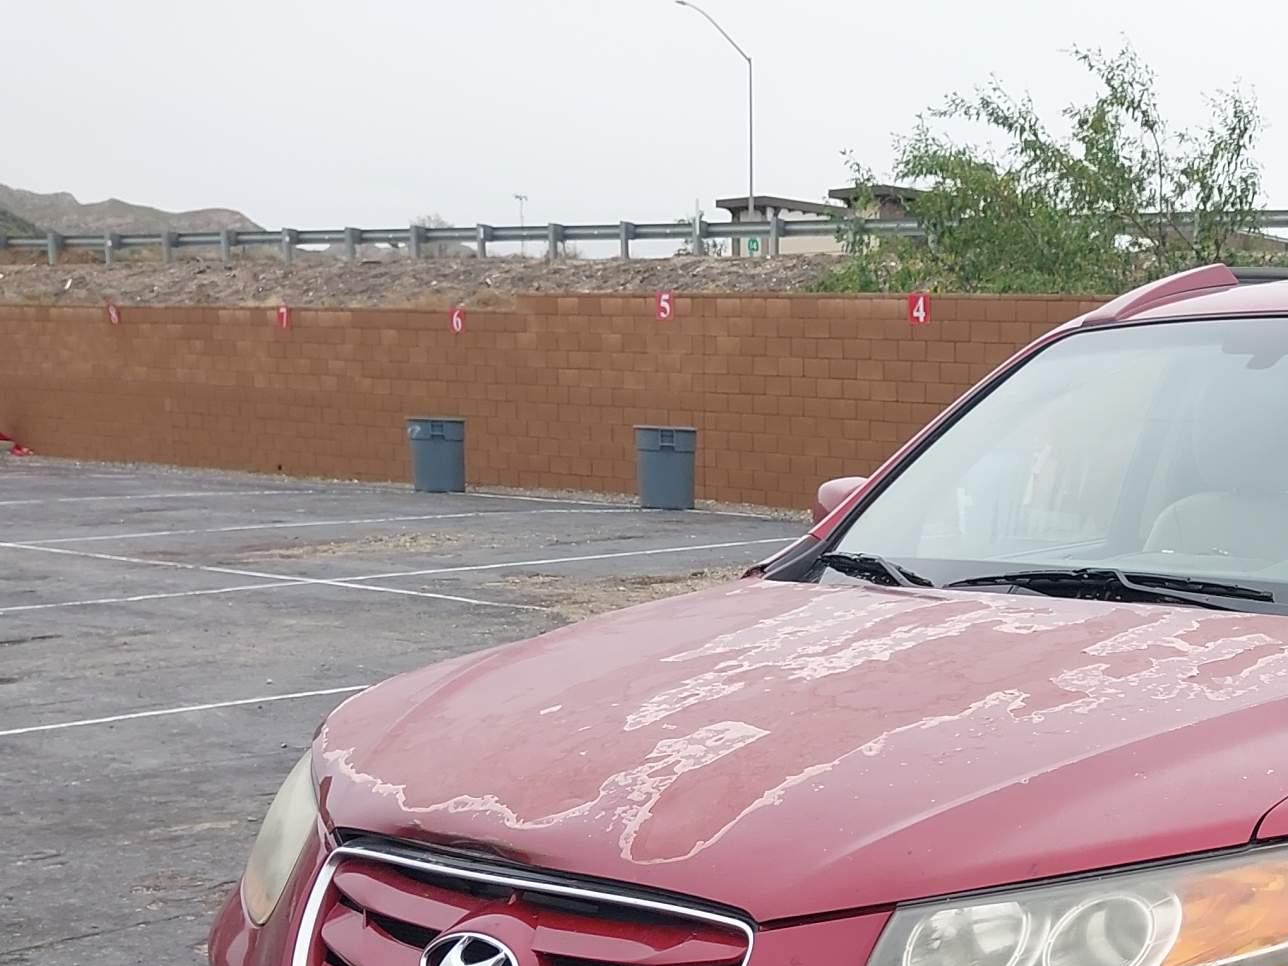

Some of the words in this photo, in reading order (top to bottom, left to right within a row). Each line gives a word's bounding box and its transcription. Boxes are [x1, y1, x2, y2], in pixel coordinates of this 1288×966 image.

[109, 305, 118, 323] 8
[660, 294, 670, 317] 5
[913, 296, 925, 322] 4
[280, 307, 287, 328] 7
[453, 310, 461, 331] 6
